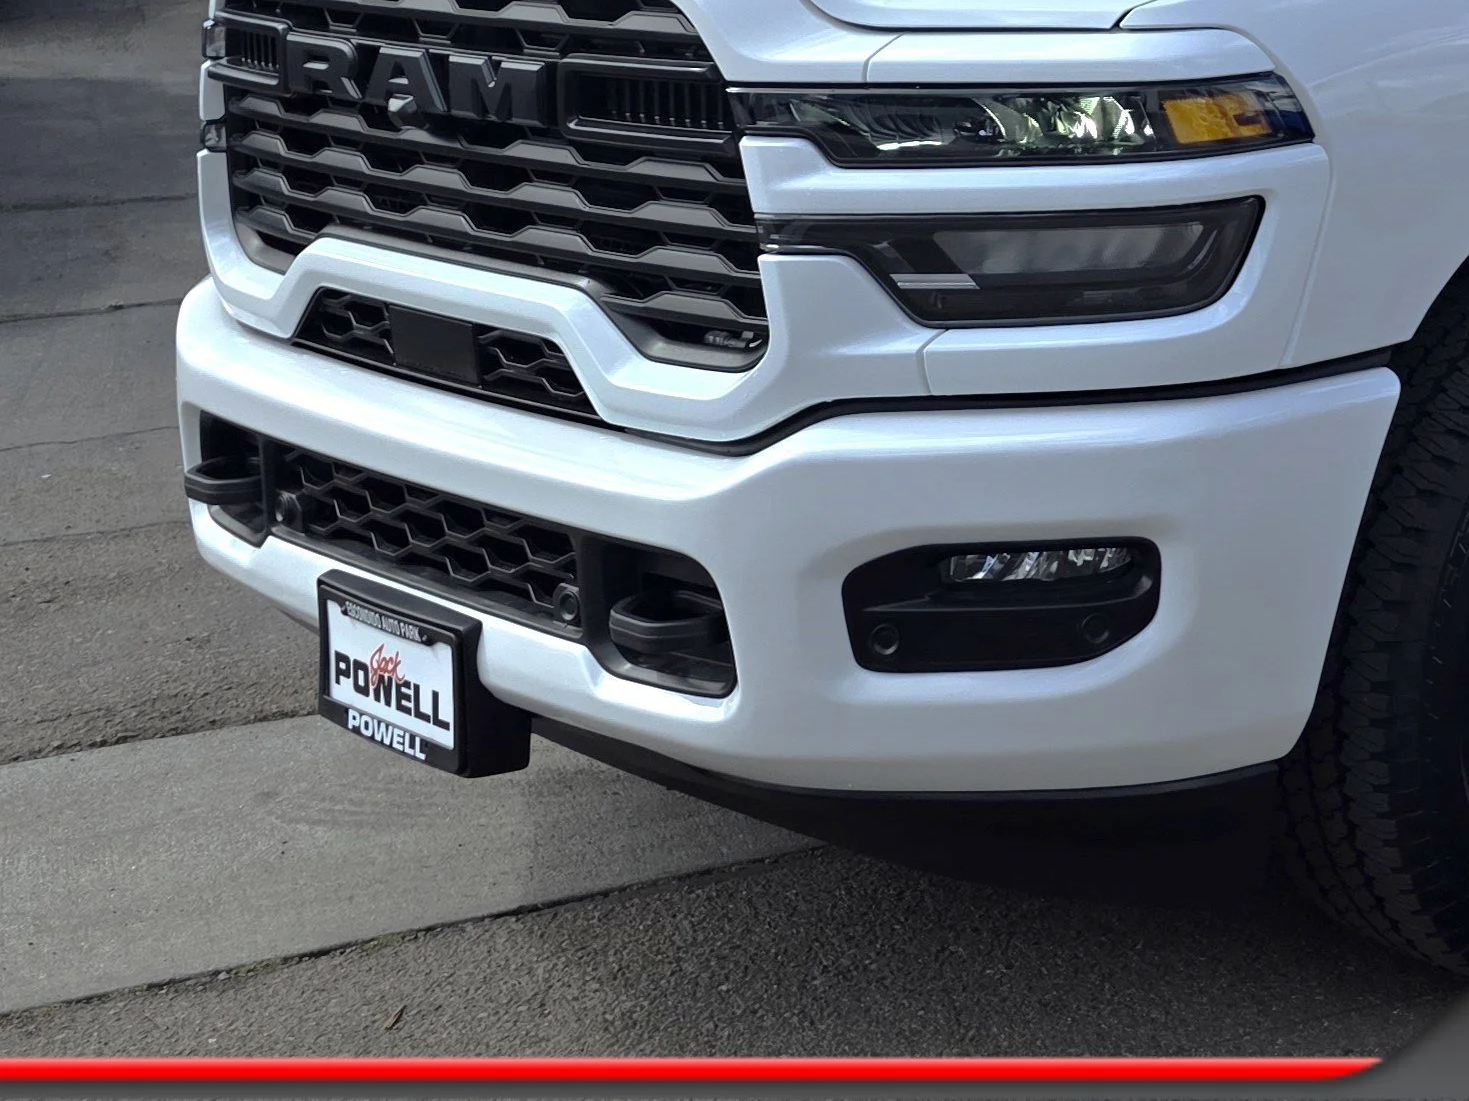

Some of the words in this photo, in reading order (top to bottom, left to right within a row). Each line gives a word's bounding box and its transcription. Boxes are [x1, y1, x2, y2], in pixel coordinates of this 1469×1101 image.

[286, 32, 547, 127] RAM
[335, 650, 450, 731] POWELL
[370, 643, 405, 689] Jack
[348, 709, 426, 760] POWELL
